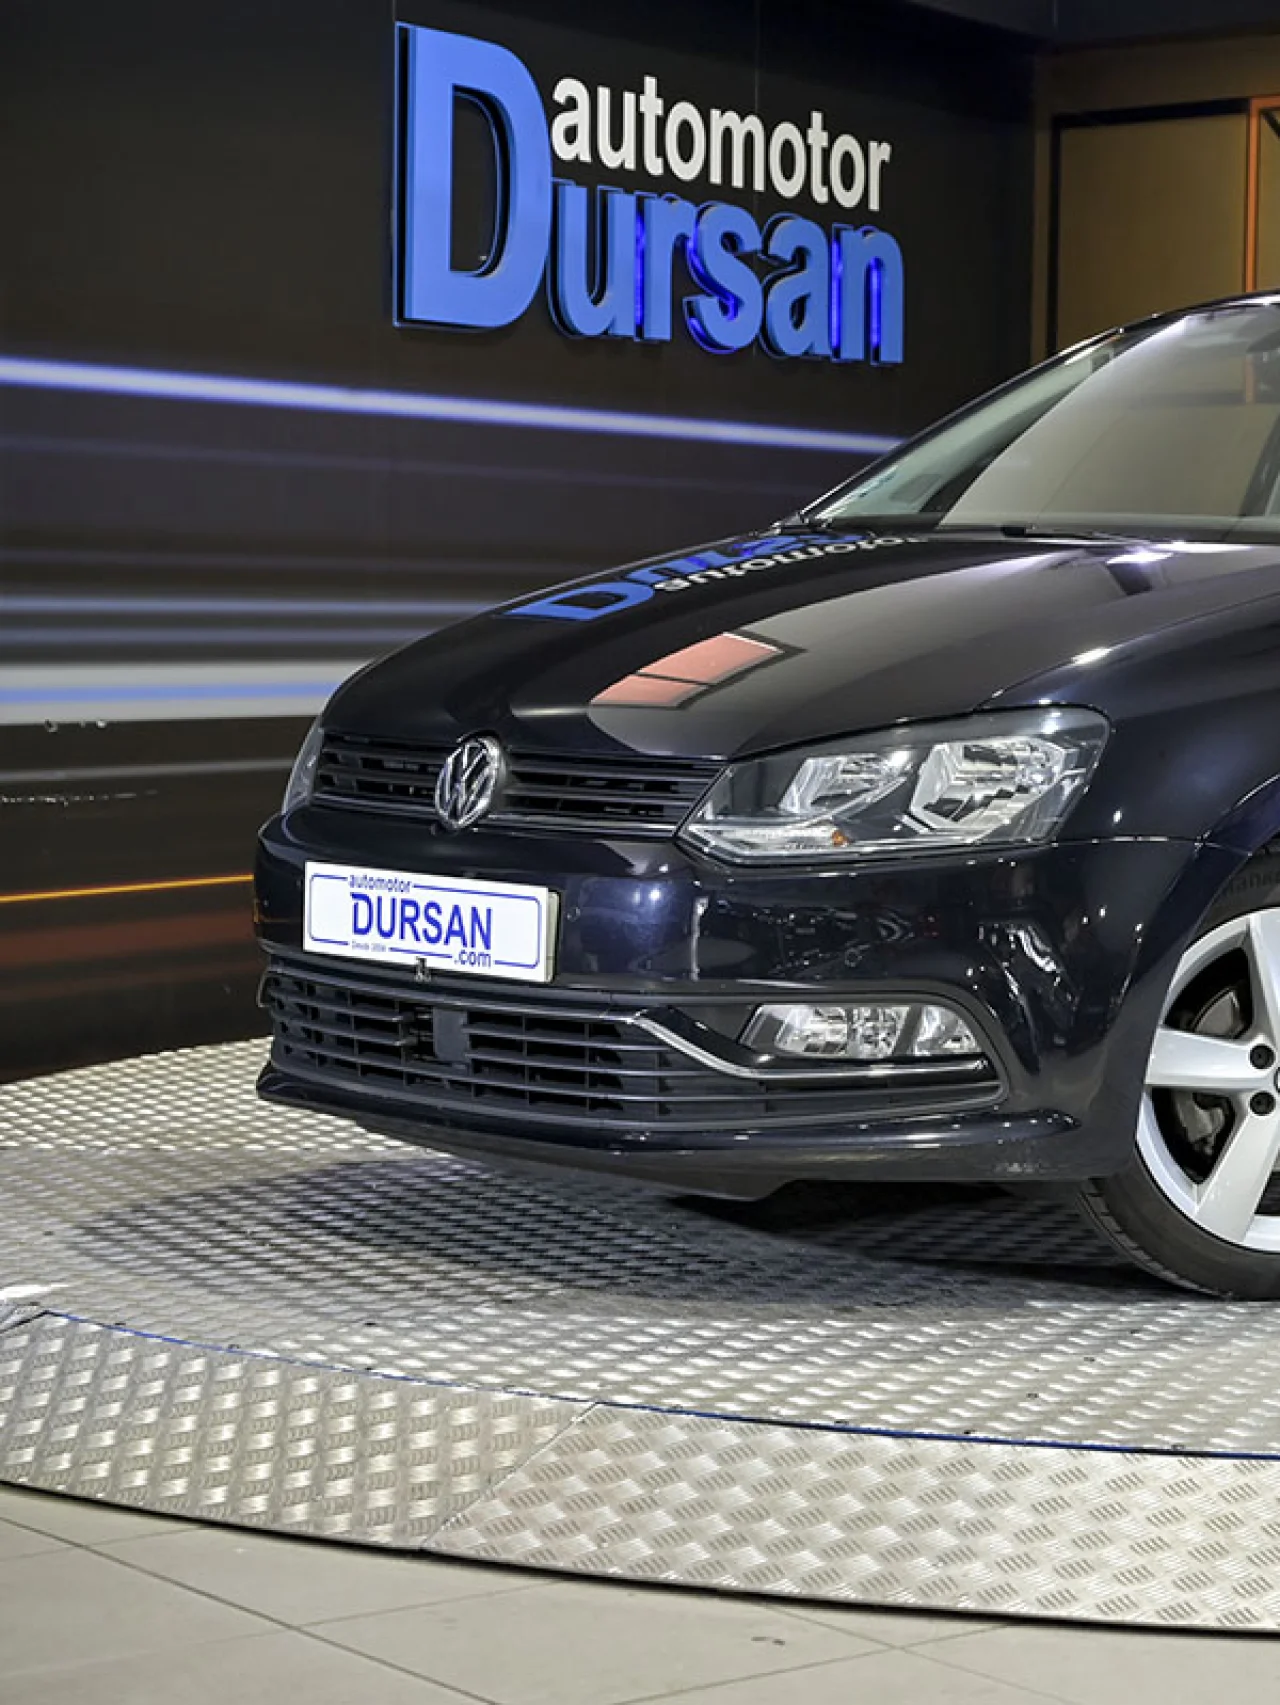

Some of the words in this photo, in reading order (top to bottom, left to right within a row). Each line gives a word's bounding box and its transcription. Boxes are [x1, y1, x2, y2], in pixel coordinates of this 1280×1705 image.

[551, 75, 892, 211] automotor
[393, 20, 904, 364] Dursan
[350, 874, 411, 893] automotor
[350, 891, 492, 950] DURSAN
[454, 949, 492, 969] .com
